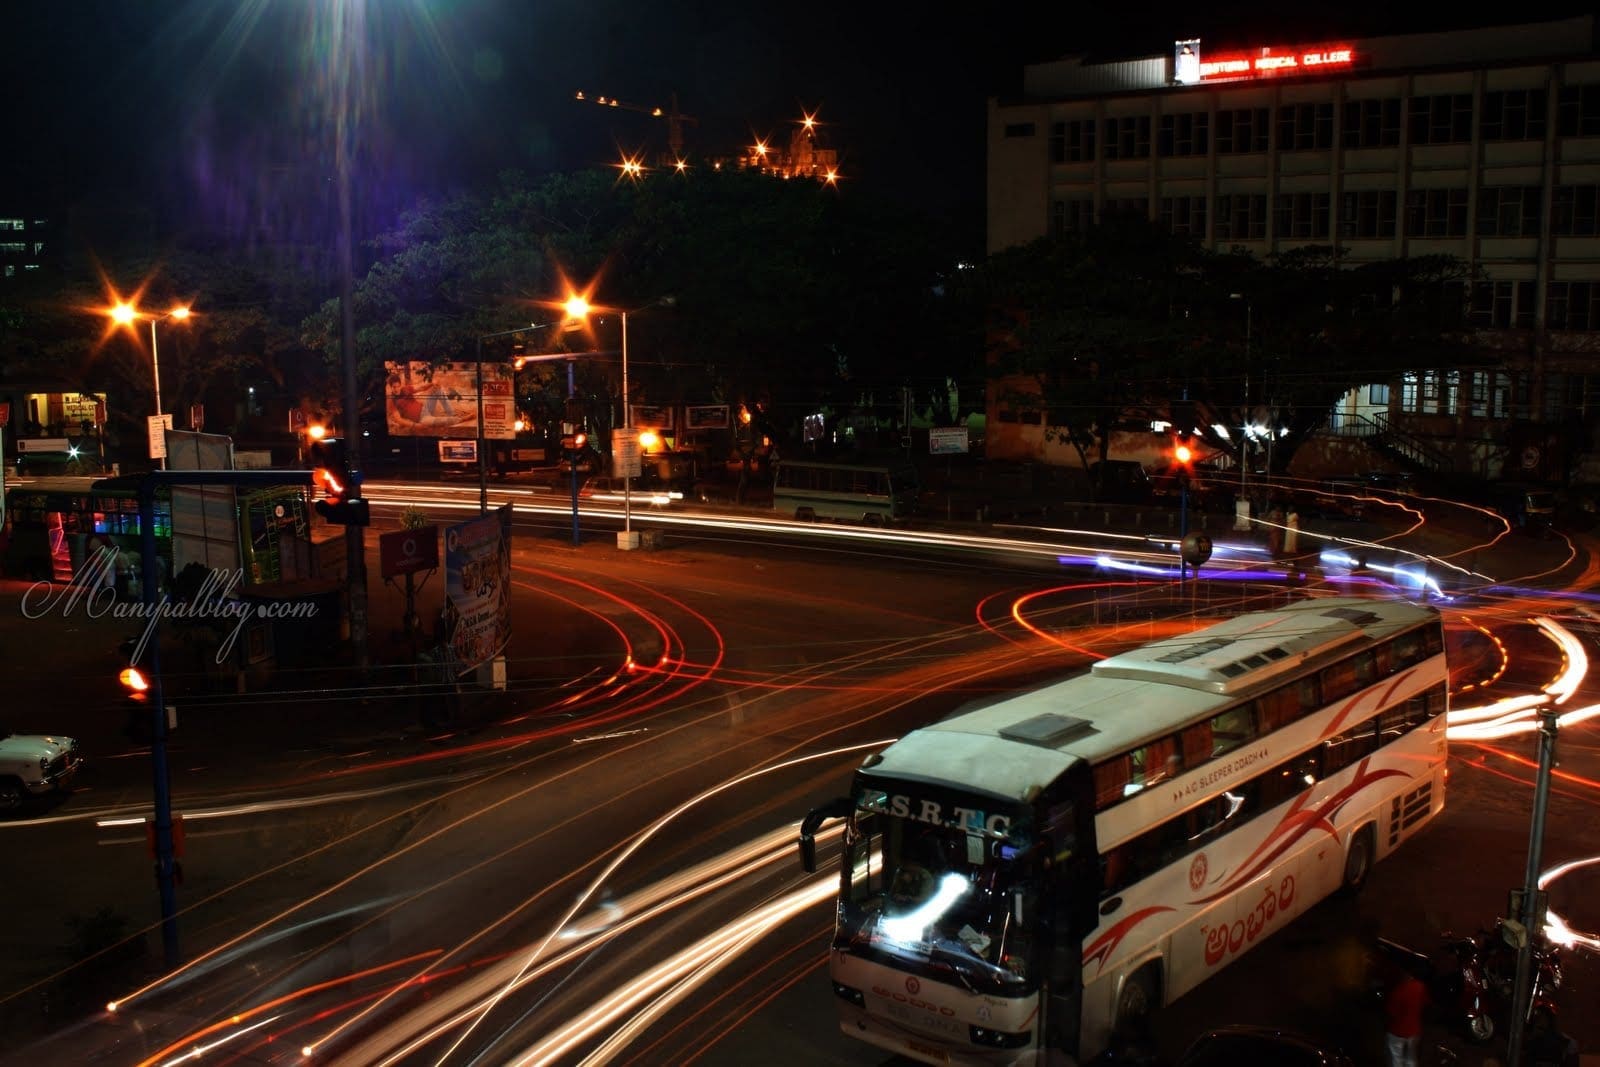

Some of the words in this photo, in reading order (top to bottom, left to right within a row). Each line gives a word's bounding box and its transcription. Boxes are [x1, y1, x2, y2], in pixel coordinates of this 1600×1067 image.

[1255, 56, 1297, 69] MEDICAL
[1303, 50, 1351, 65] COLLEGE
[1200, 764, 1233, 789] SLEEPER
[1234, 752, 1258, 772] COACH
